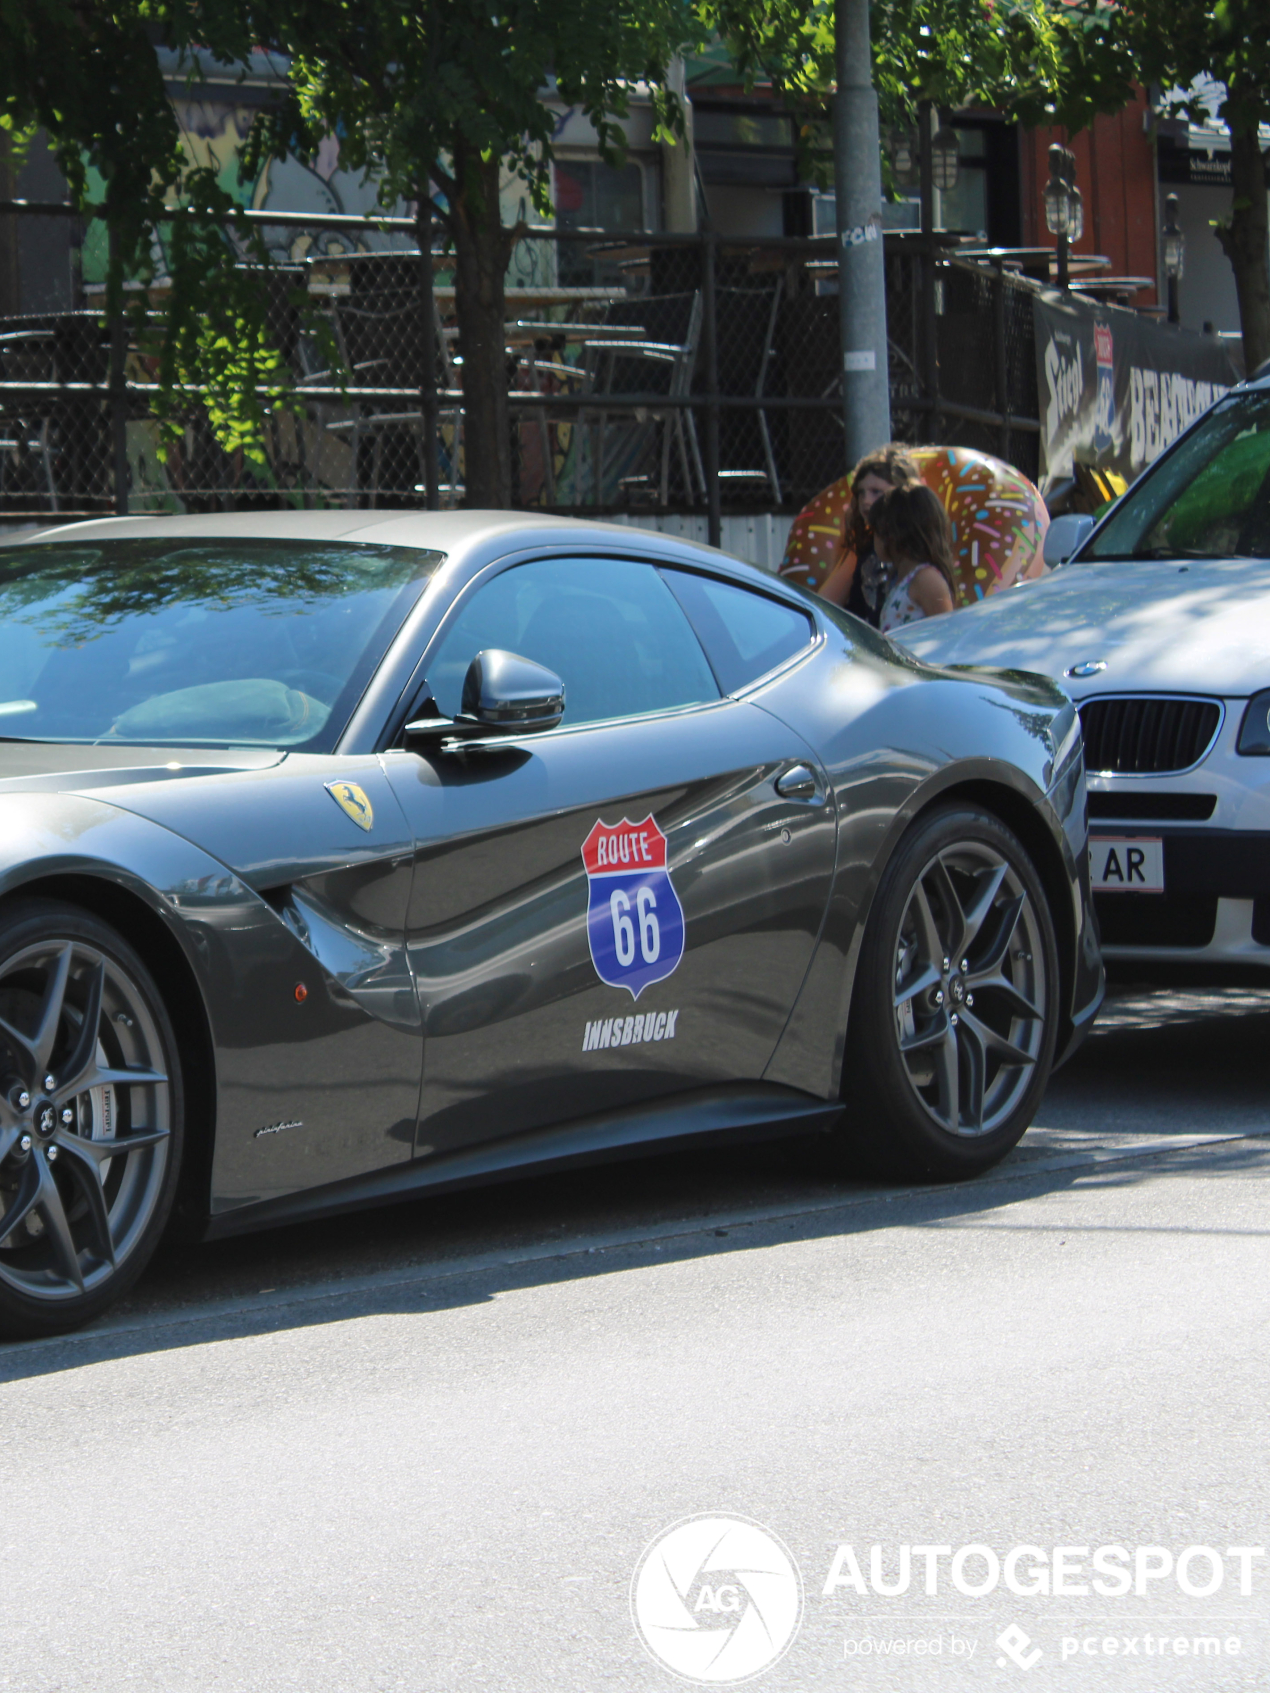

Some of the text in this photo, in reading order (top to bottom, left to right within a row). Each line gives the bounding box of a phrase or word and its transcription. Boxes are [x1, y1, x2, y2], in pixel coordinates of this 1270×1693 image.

[1189, 156, 1232, 175] Schwarzkopf
[597, 831, 653, 866] ROUTE
[1102, 847, 1146, 882] AR
[609, 886, 661, 967] 66
[581, 1009, 679, 1052] INNSBRUCK
